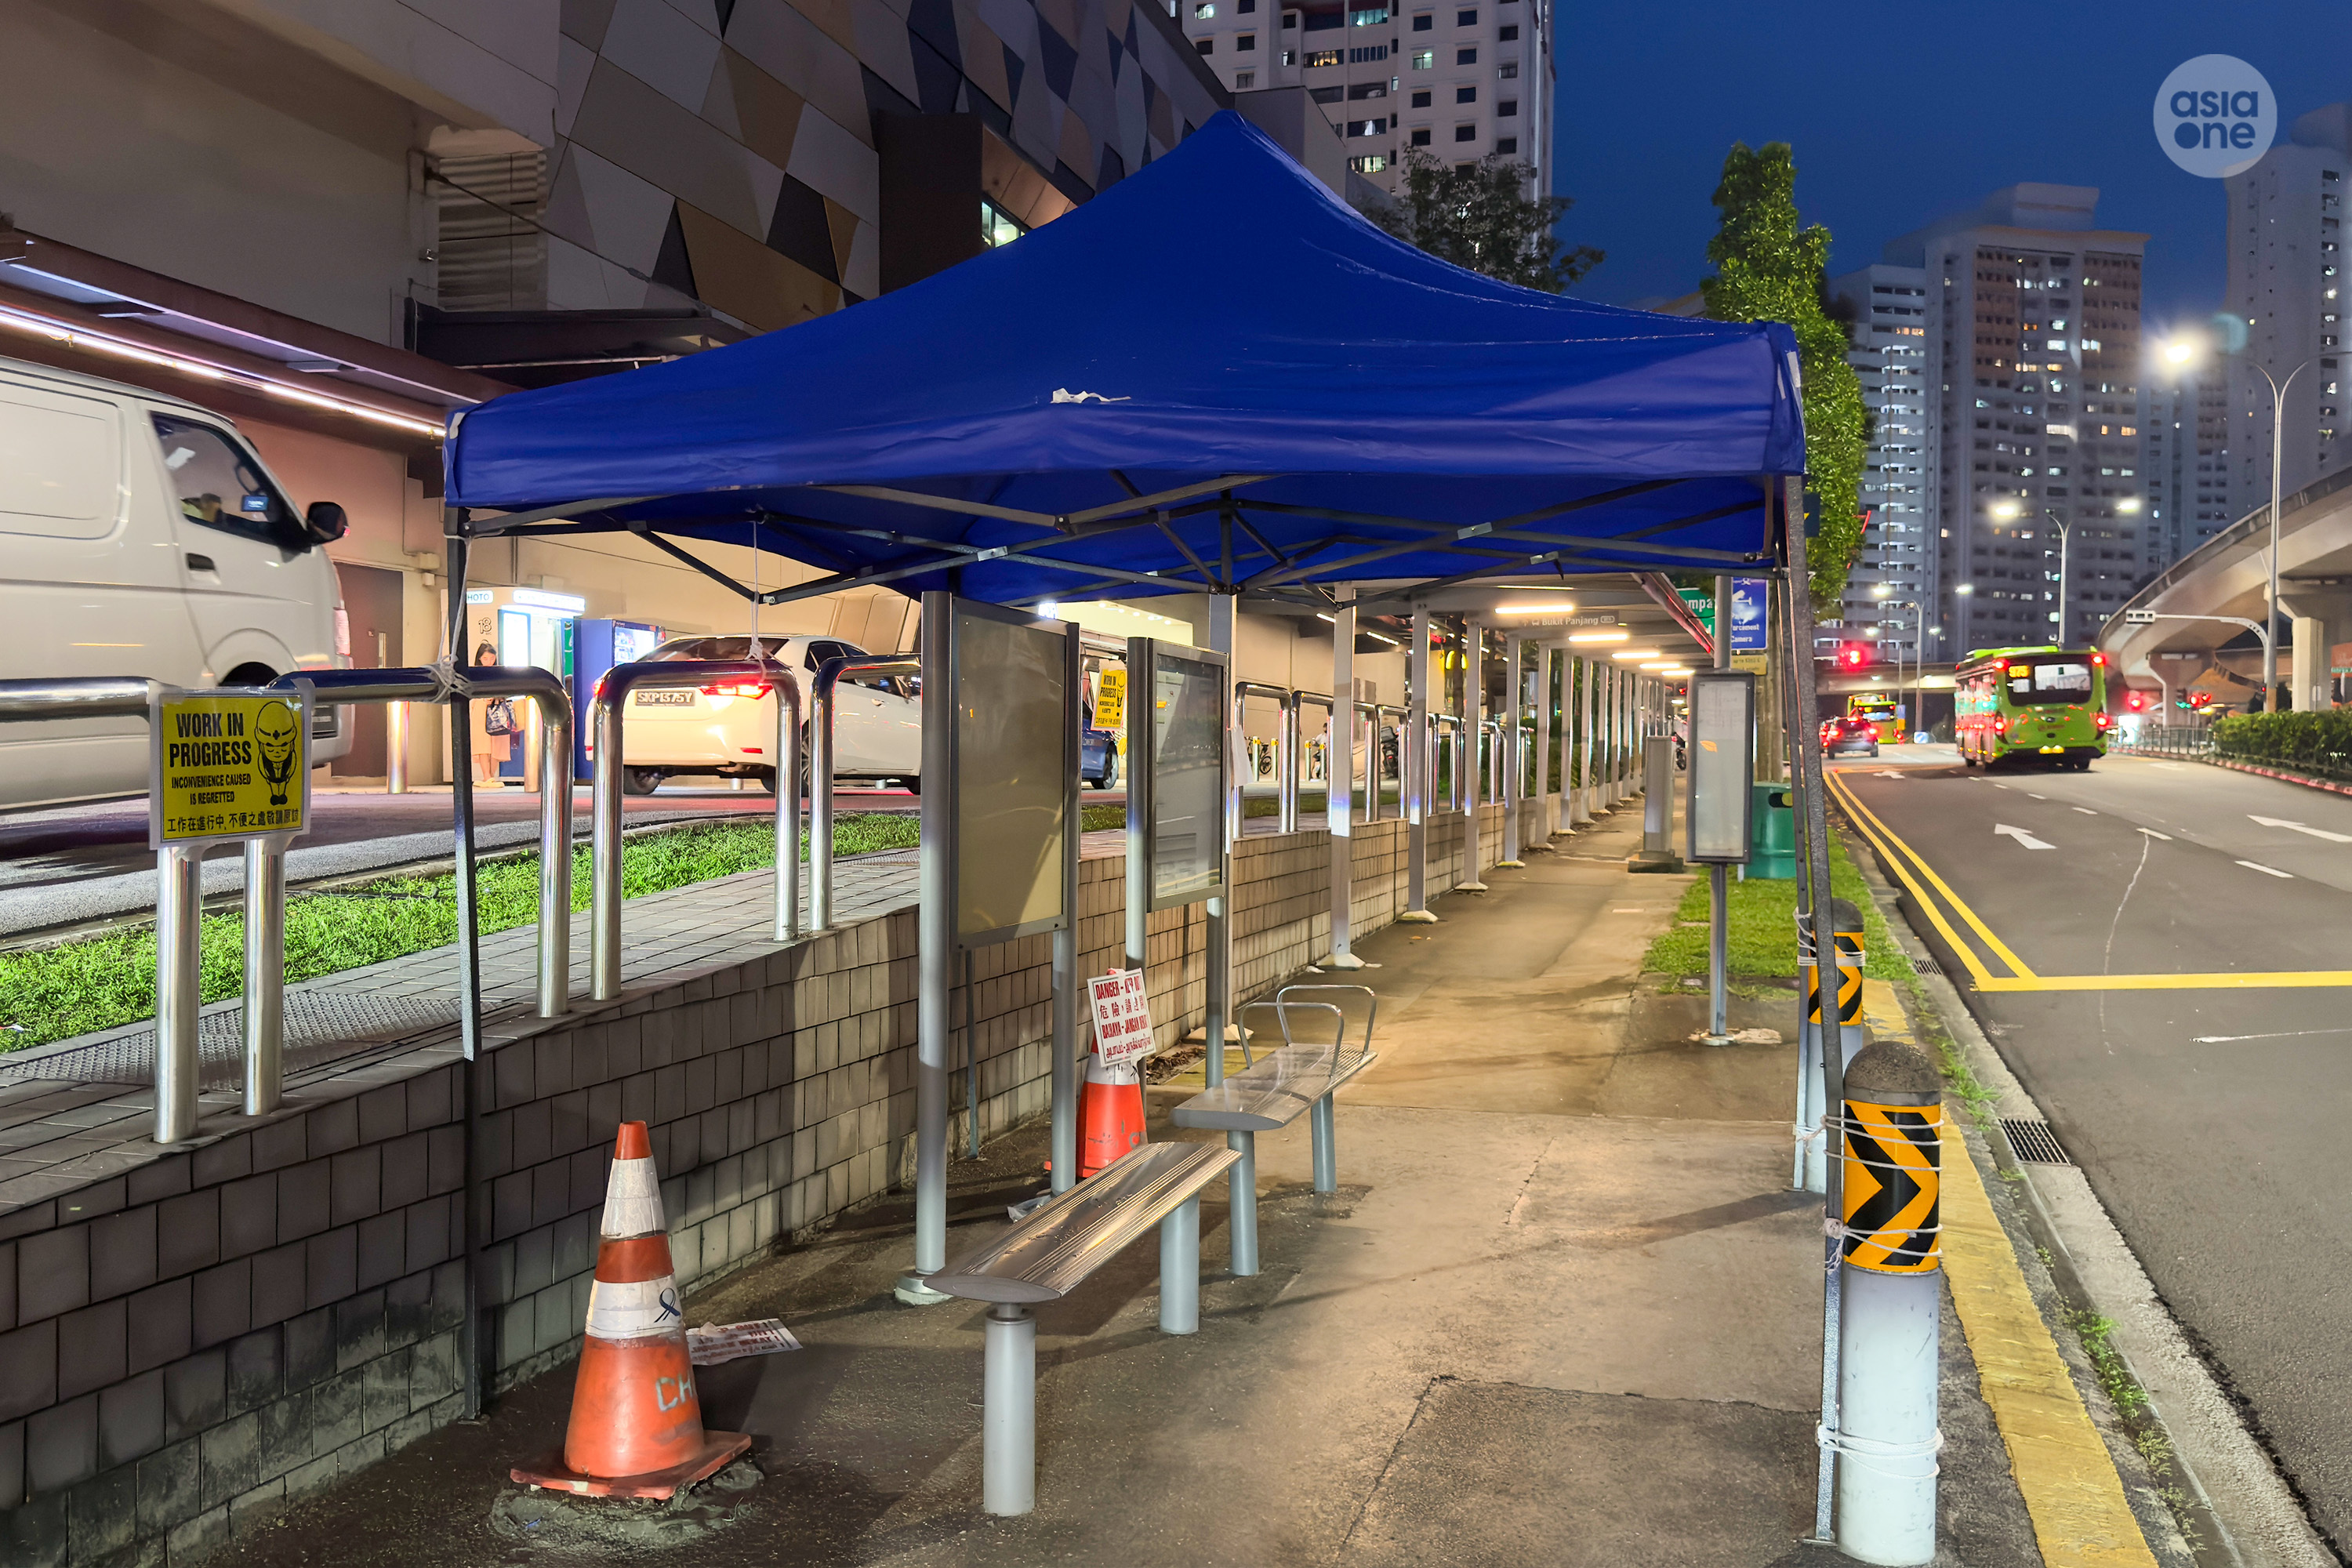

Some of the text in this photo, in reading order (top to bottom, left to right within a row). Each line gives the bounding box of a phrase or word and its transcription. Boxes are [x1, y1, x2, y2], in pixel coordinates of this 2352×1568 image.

[467, 593, 490, 601] HOTO
[1566, 616, 1599, 626] Panjang
[2009, 665, 2029, 678] 975
[637, 692, 693, 703] SKP1375Y
[176, 713, 244, 738] WORK IN
[169, 741, 252, 768] PROGRESS
[171, 773, 252, 789] INCONVENIENCE CAUSED
[190, 791, 235, 805] IS REGRETTED
[1095, 981, 1120, 1000] DANGER
